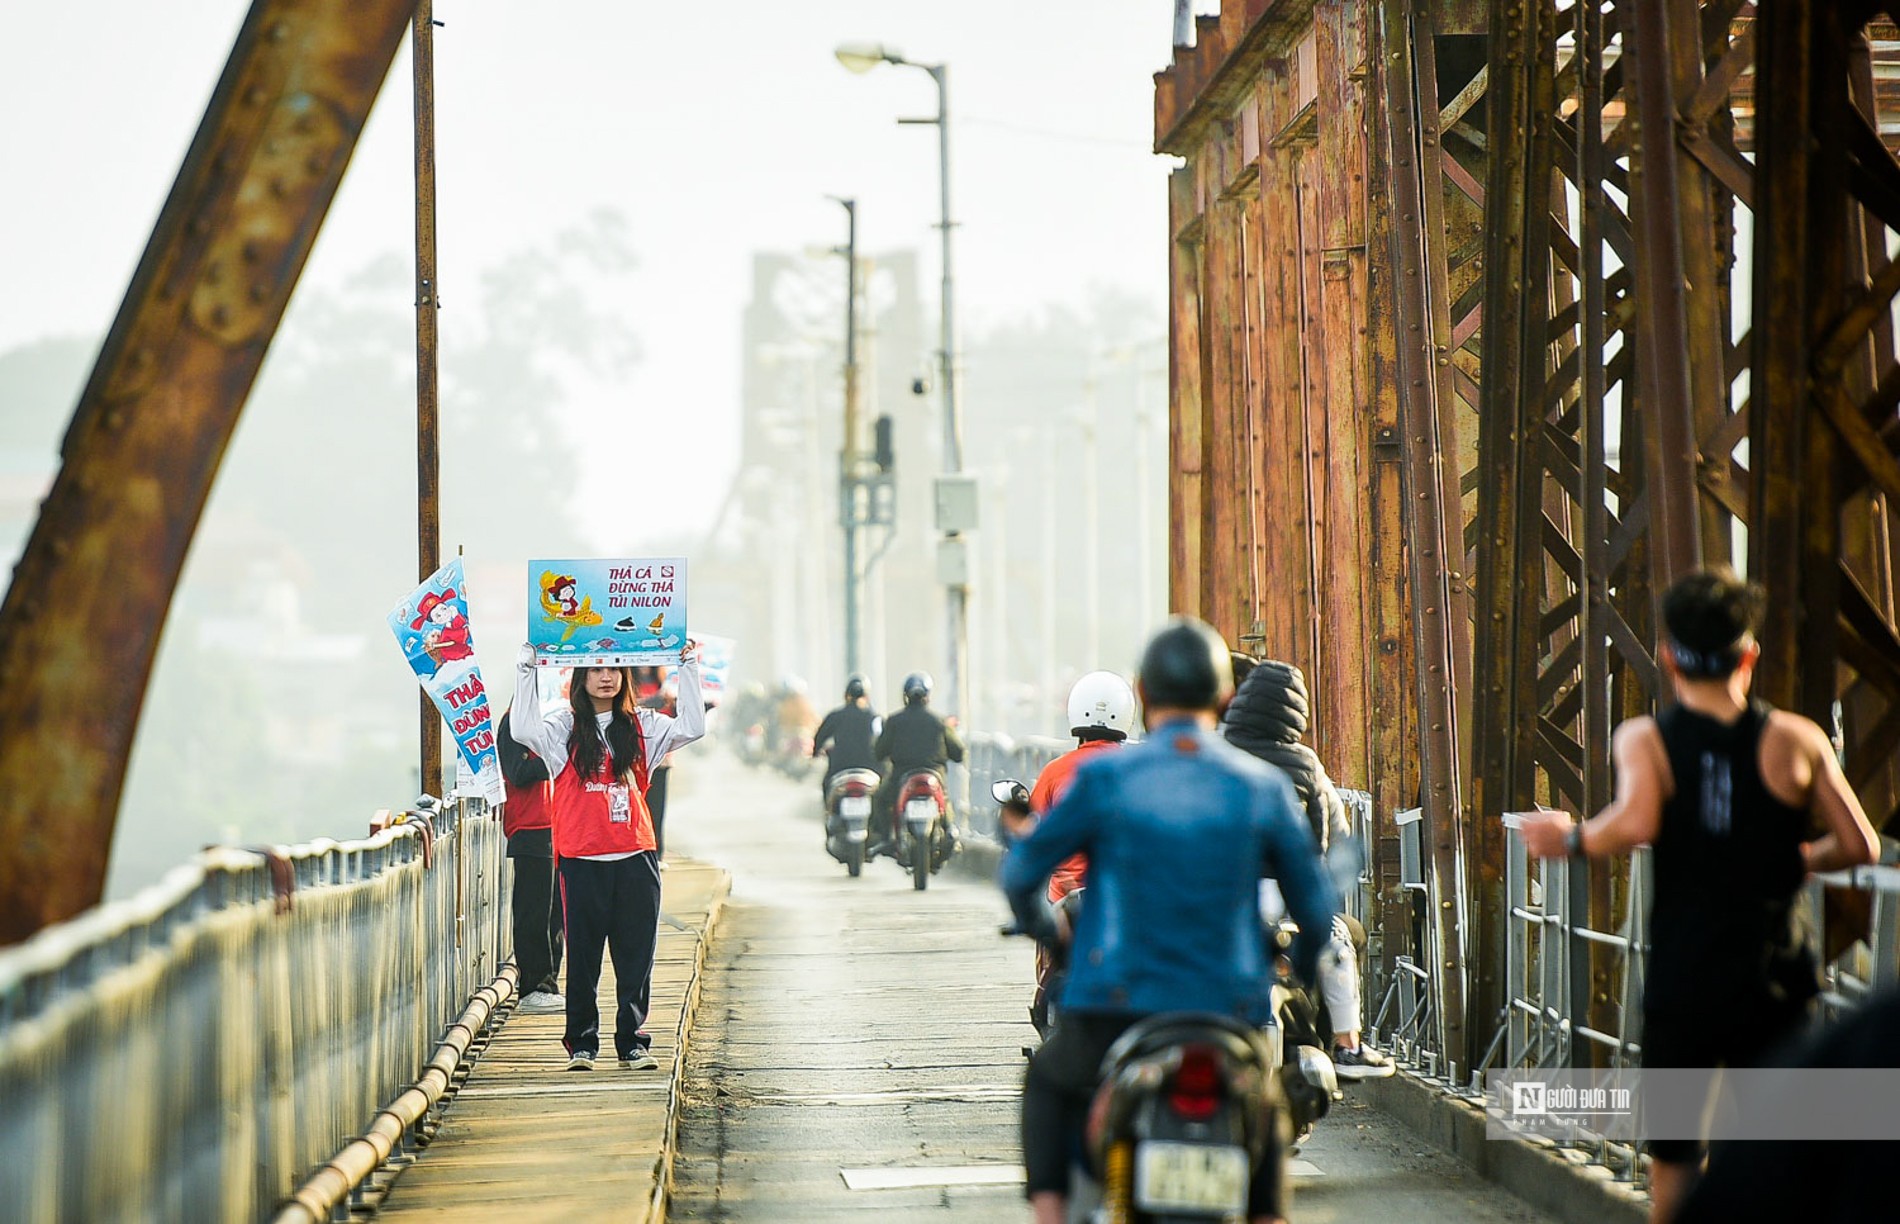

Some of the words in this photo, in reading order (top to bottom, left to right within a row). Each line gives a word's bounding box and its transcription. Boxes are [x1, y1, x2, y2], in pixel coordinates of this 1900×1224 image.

[609, 565, 632, 579] THẢ
[635, 565, 652, 579] CÁ
[609, 580, 647, 593] ĐỪNG
[651, 579, 674, 593] THẢ
[608, 594, 628, 608] TÚI
[630, 596, 672, 608] NILON
[443, 673, 485, 709] THẢ
[453, 703, 491, 735] ĐỪN
[464, 730, 494, 755] TÚI
